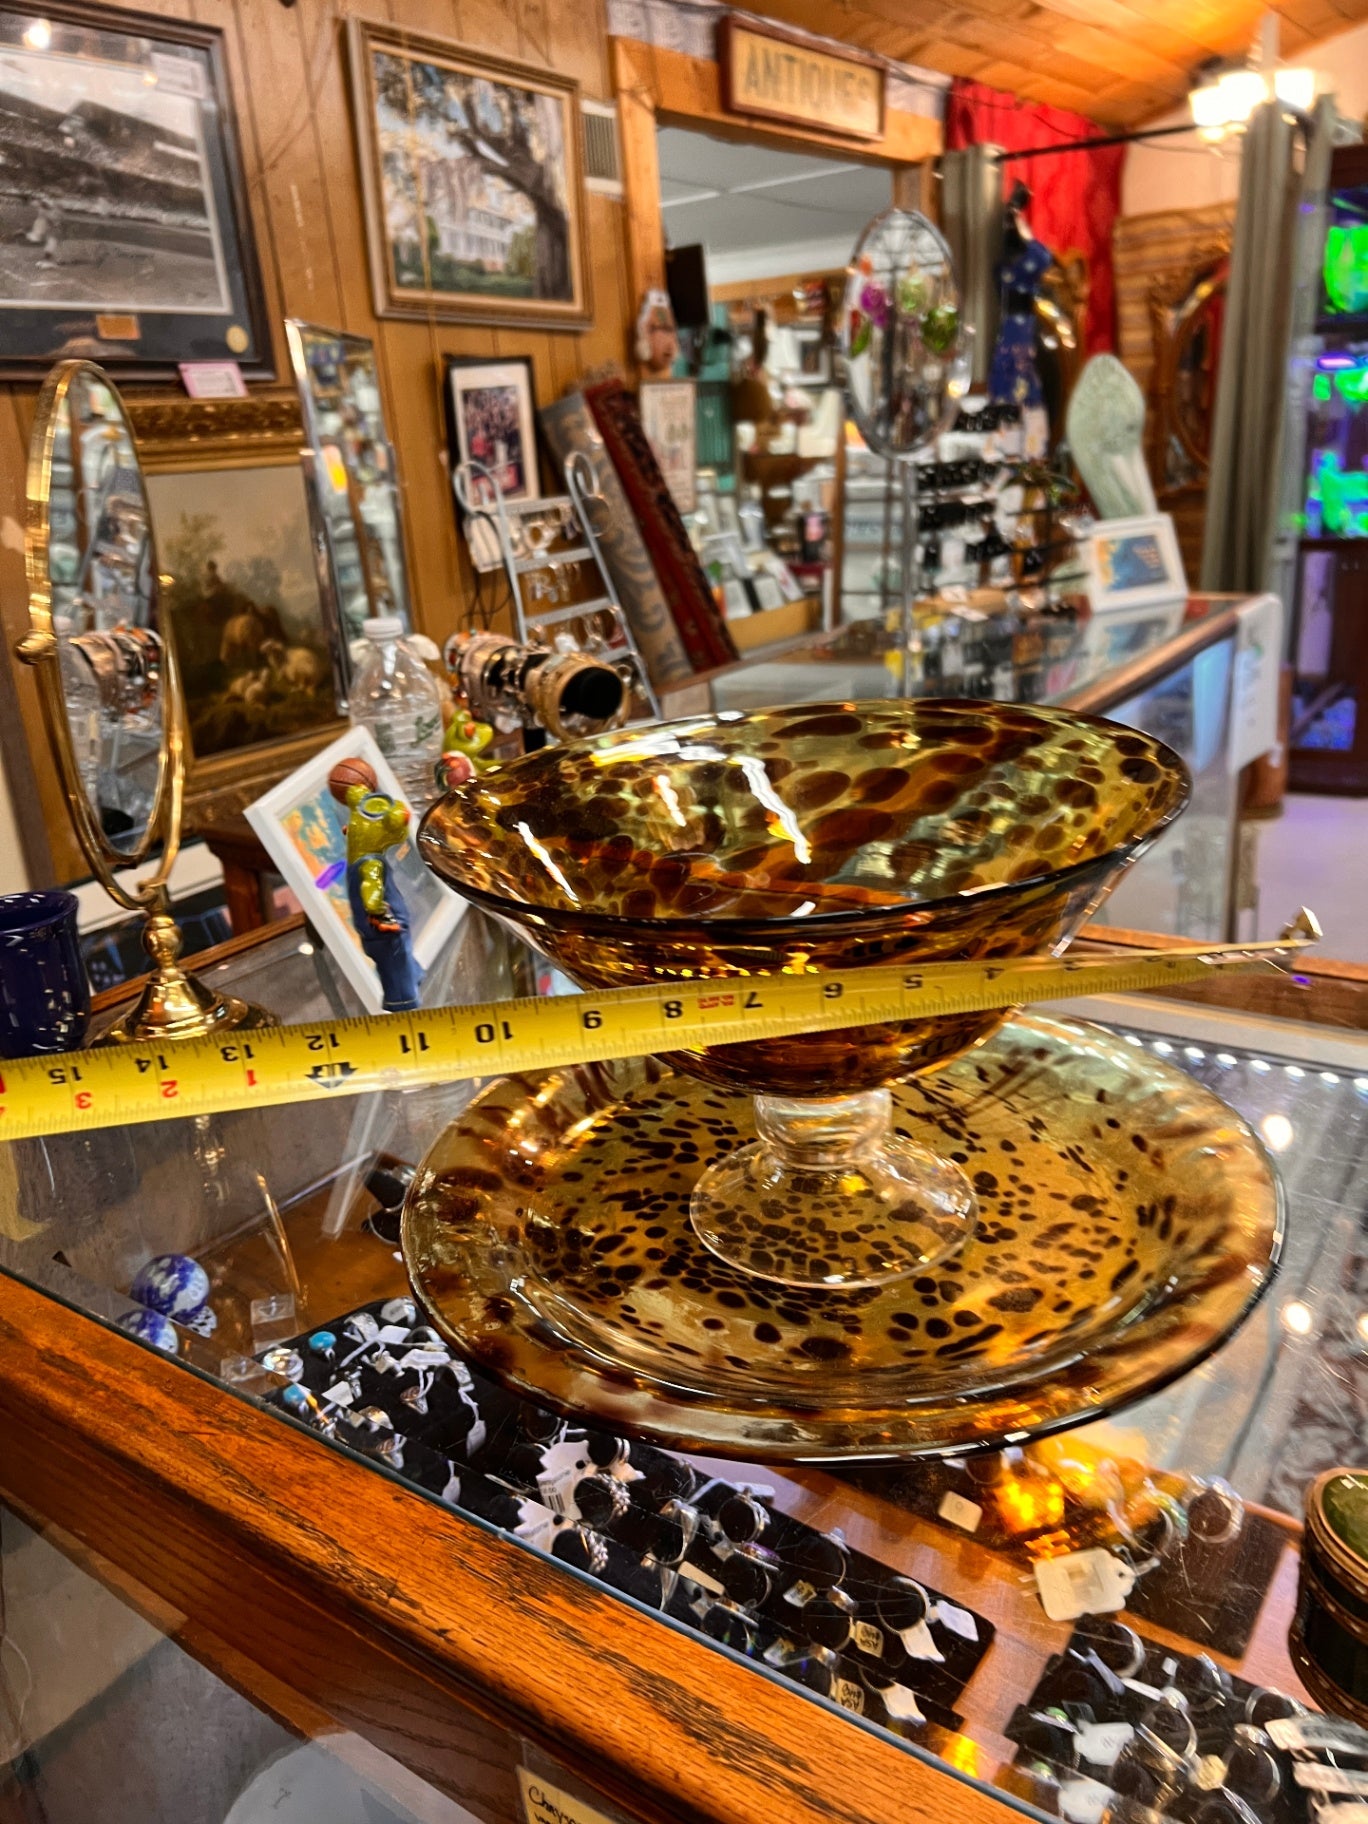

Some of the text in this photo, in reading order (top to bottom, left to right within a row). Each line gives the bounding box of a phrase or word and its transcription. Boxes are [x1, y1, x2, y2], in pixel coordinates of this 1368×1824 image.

[744, 43, 869, 116] ANTIQUES
[903, 973, 923, 989] 5
[824, 982, 843, 999] 6
[664, 1000, 684, 1018] 8
[744, 992, 763, 1009] 7
[583, 1010, 603, 1030] 9
[305, 1032, 341, 1051] 12
[475, 1021, 513, 1044] 10
[400, 1032, 431, 1054] 11
[220, 1044, 255, 1062] 13
[135, 1055, 168, 1073] 14
[48, 1066, 84, 1084] 15
[75, 1069, 258, 1110] 1 2 3
